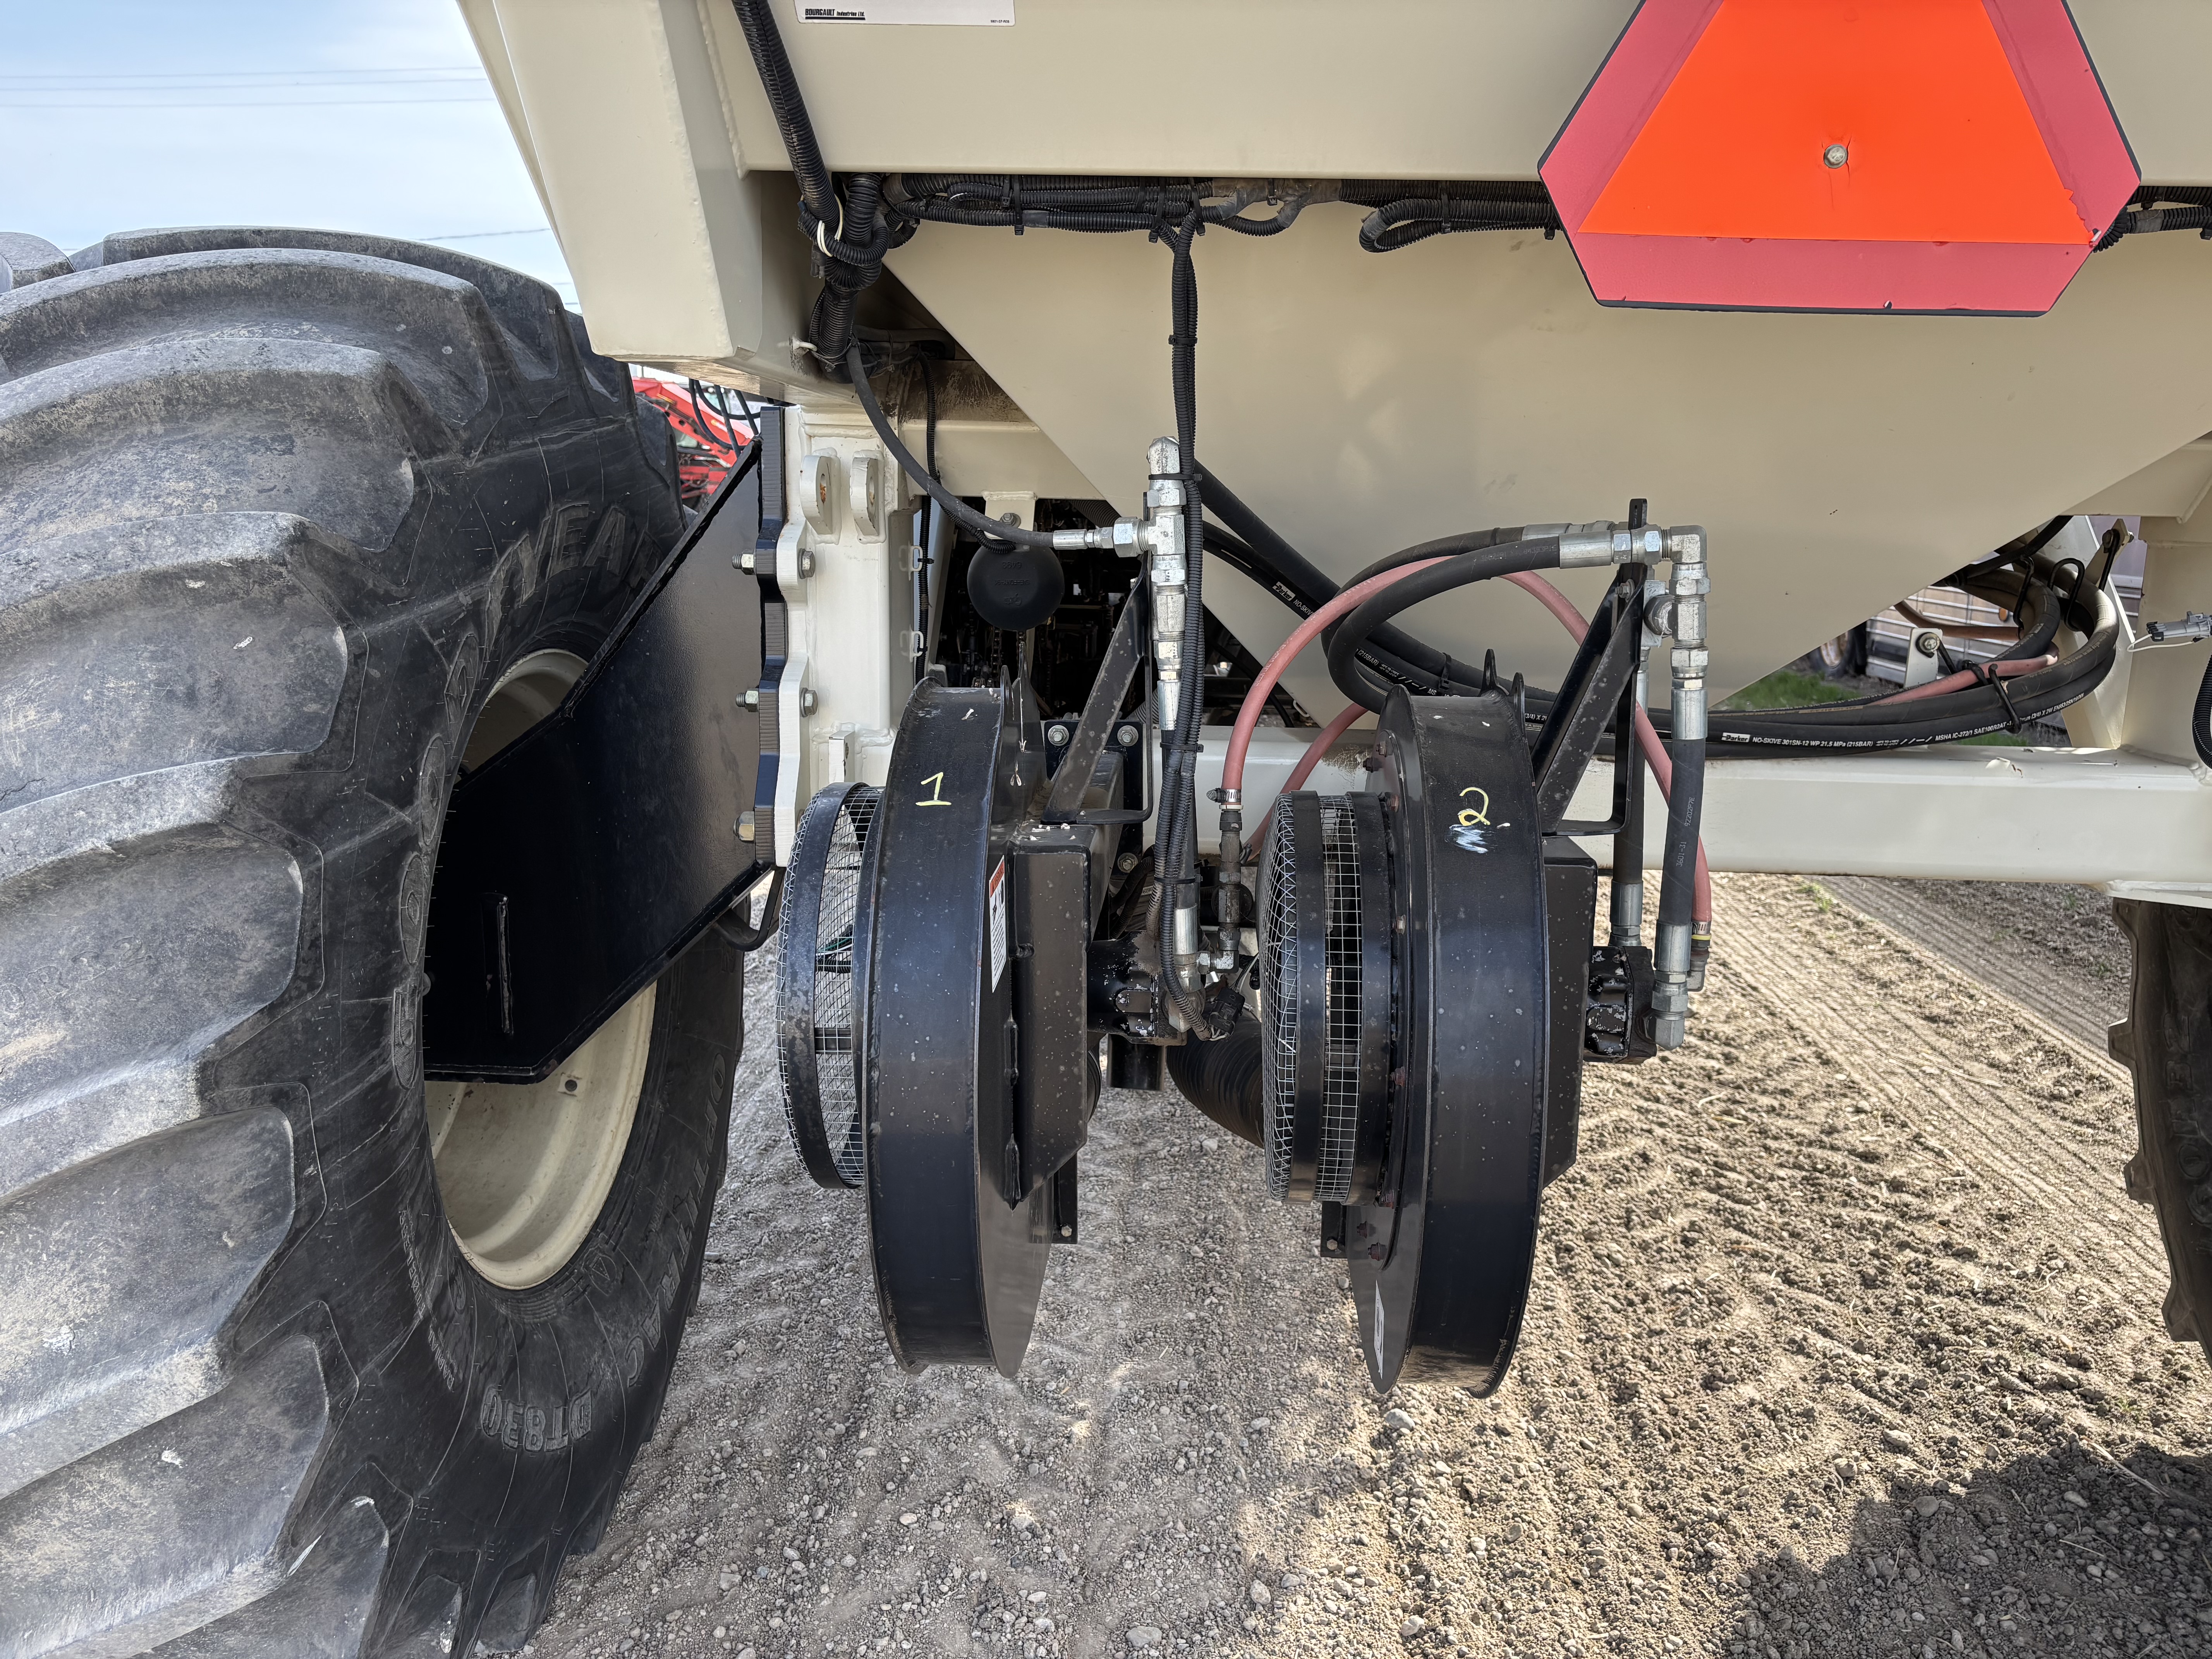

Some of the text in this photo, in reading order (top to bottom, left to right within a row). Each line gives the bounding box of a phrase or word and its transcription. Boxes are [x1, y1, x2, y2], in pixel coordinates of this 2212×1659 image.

[1274, 584, 1293, 599] Parker
[1293, 599, 1314, 615] NO-SKIV
[1357, 649, 1379, 666] (215BAR)
[1952, 730, 1973, 738] IC-272/1
[1974, 721, 2006, 735] SAE100R2AT
[2031, 711, 2041, 720] (3/4)
[915, 771, 951, 806] 1
[1457, 787, 1491, 826] 2
[1676, 842, 1686, 867] 3601-31
[625, 1053, 726, 1388] OPTITRAC
[400, 1211, 426, 1319] TUBELESS
[428, 1325, 455, 1393] RADIAL
[481, 1385, 592, 1452] DT830
